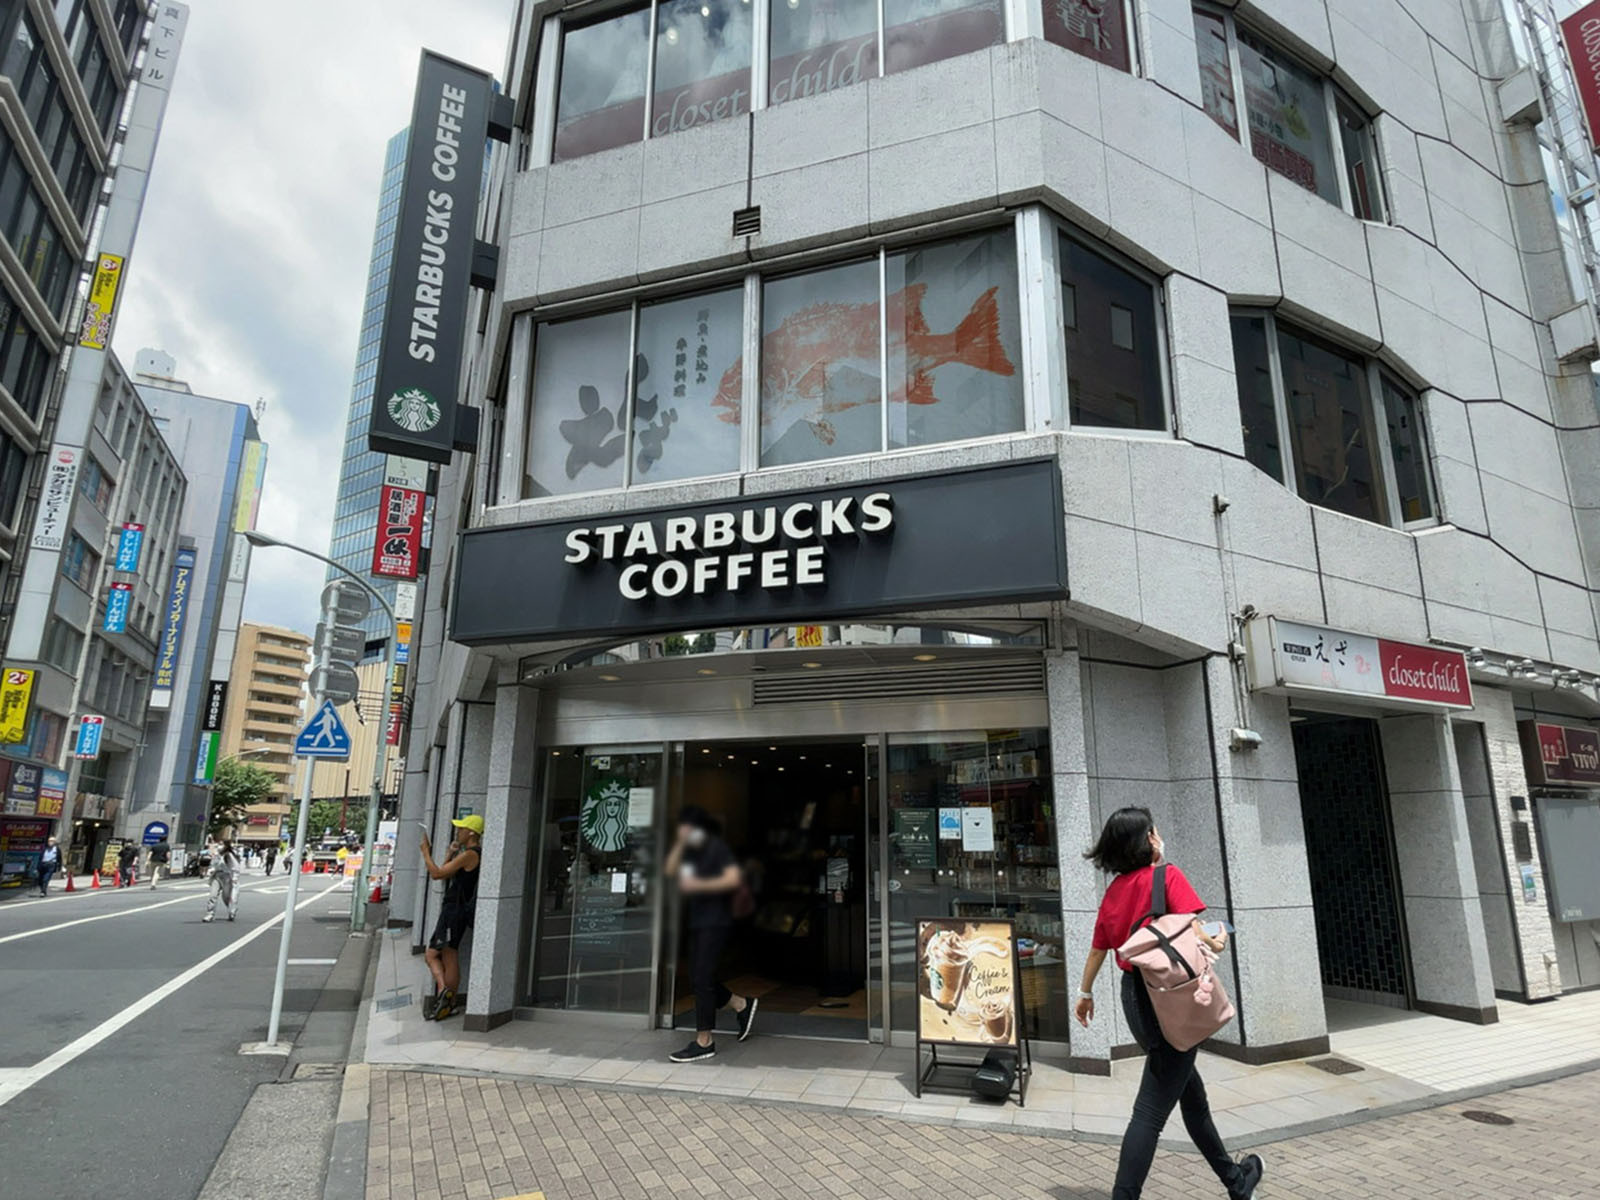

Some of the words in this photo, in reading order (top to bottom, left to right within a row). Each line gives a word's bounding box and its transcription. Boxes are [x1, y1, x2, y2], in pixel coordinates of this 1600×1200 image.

[652, 88, 748, 137] closet
[771, 38, 874, 105] child
[408, 189, 454, 364] STARBUCKS
[431, 83, 467, 182] COFFEE
[564, 492, 893, 564] STARBUCKS
[117, 531, 135, 571] らしんばん
[618, 546, 824, 600] COFFEE
[105, 590, 124, 632] らしんばん
[7, 671, 29, 684] 2F
[1389, 655, 1428, 689] closet
[1426, 661, 1461, 693] child
[969, 965, 1000, 987] Coffee
[975, 981, 1010, 999] Cream
